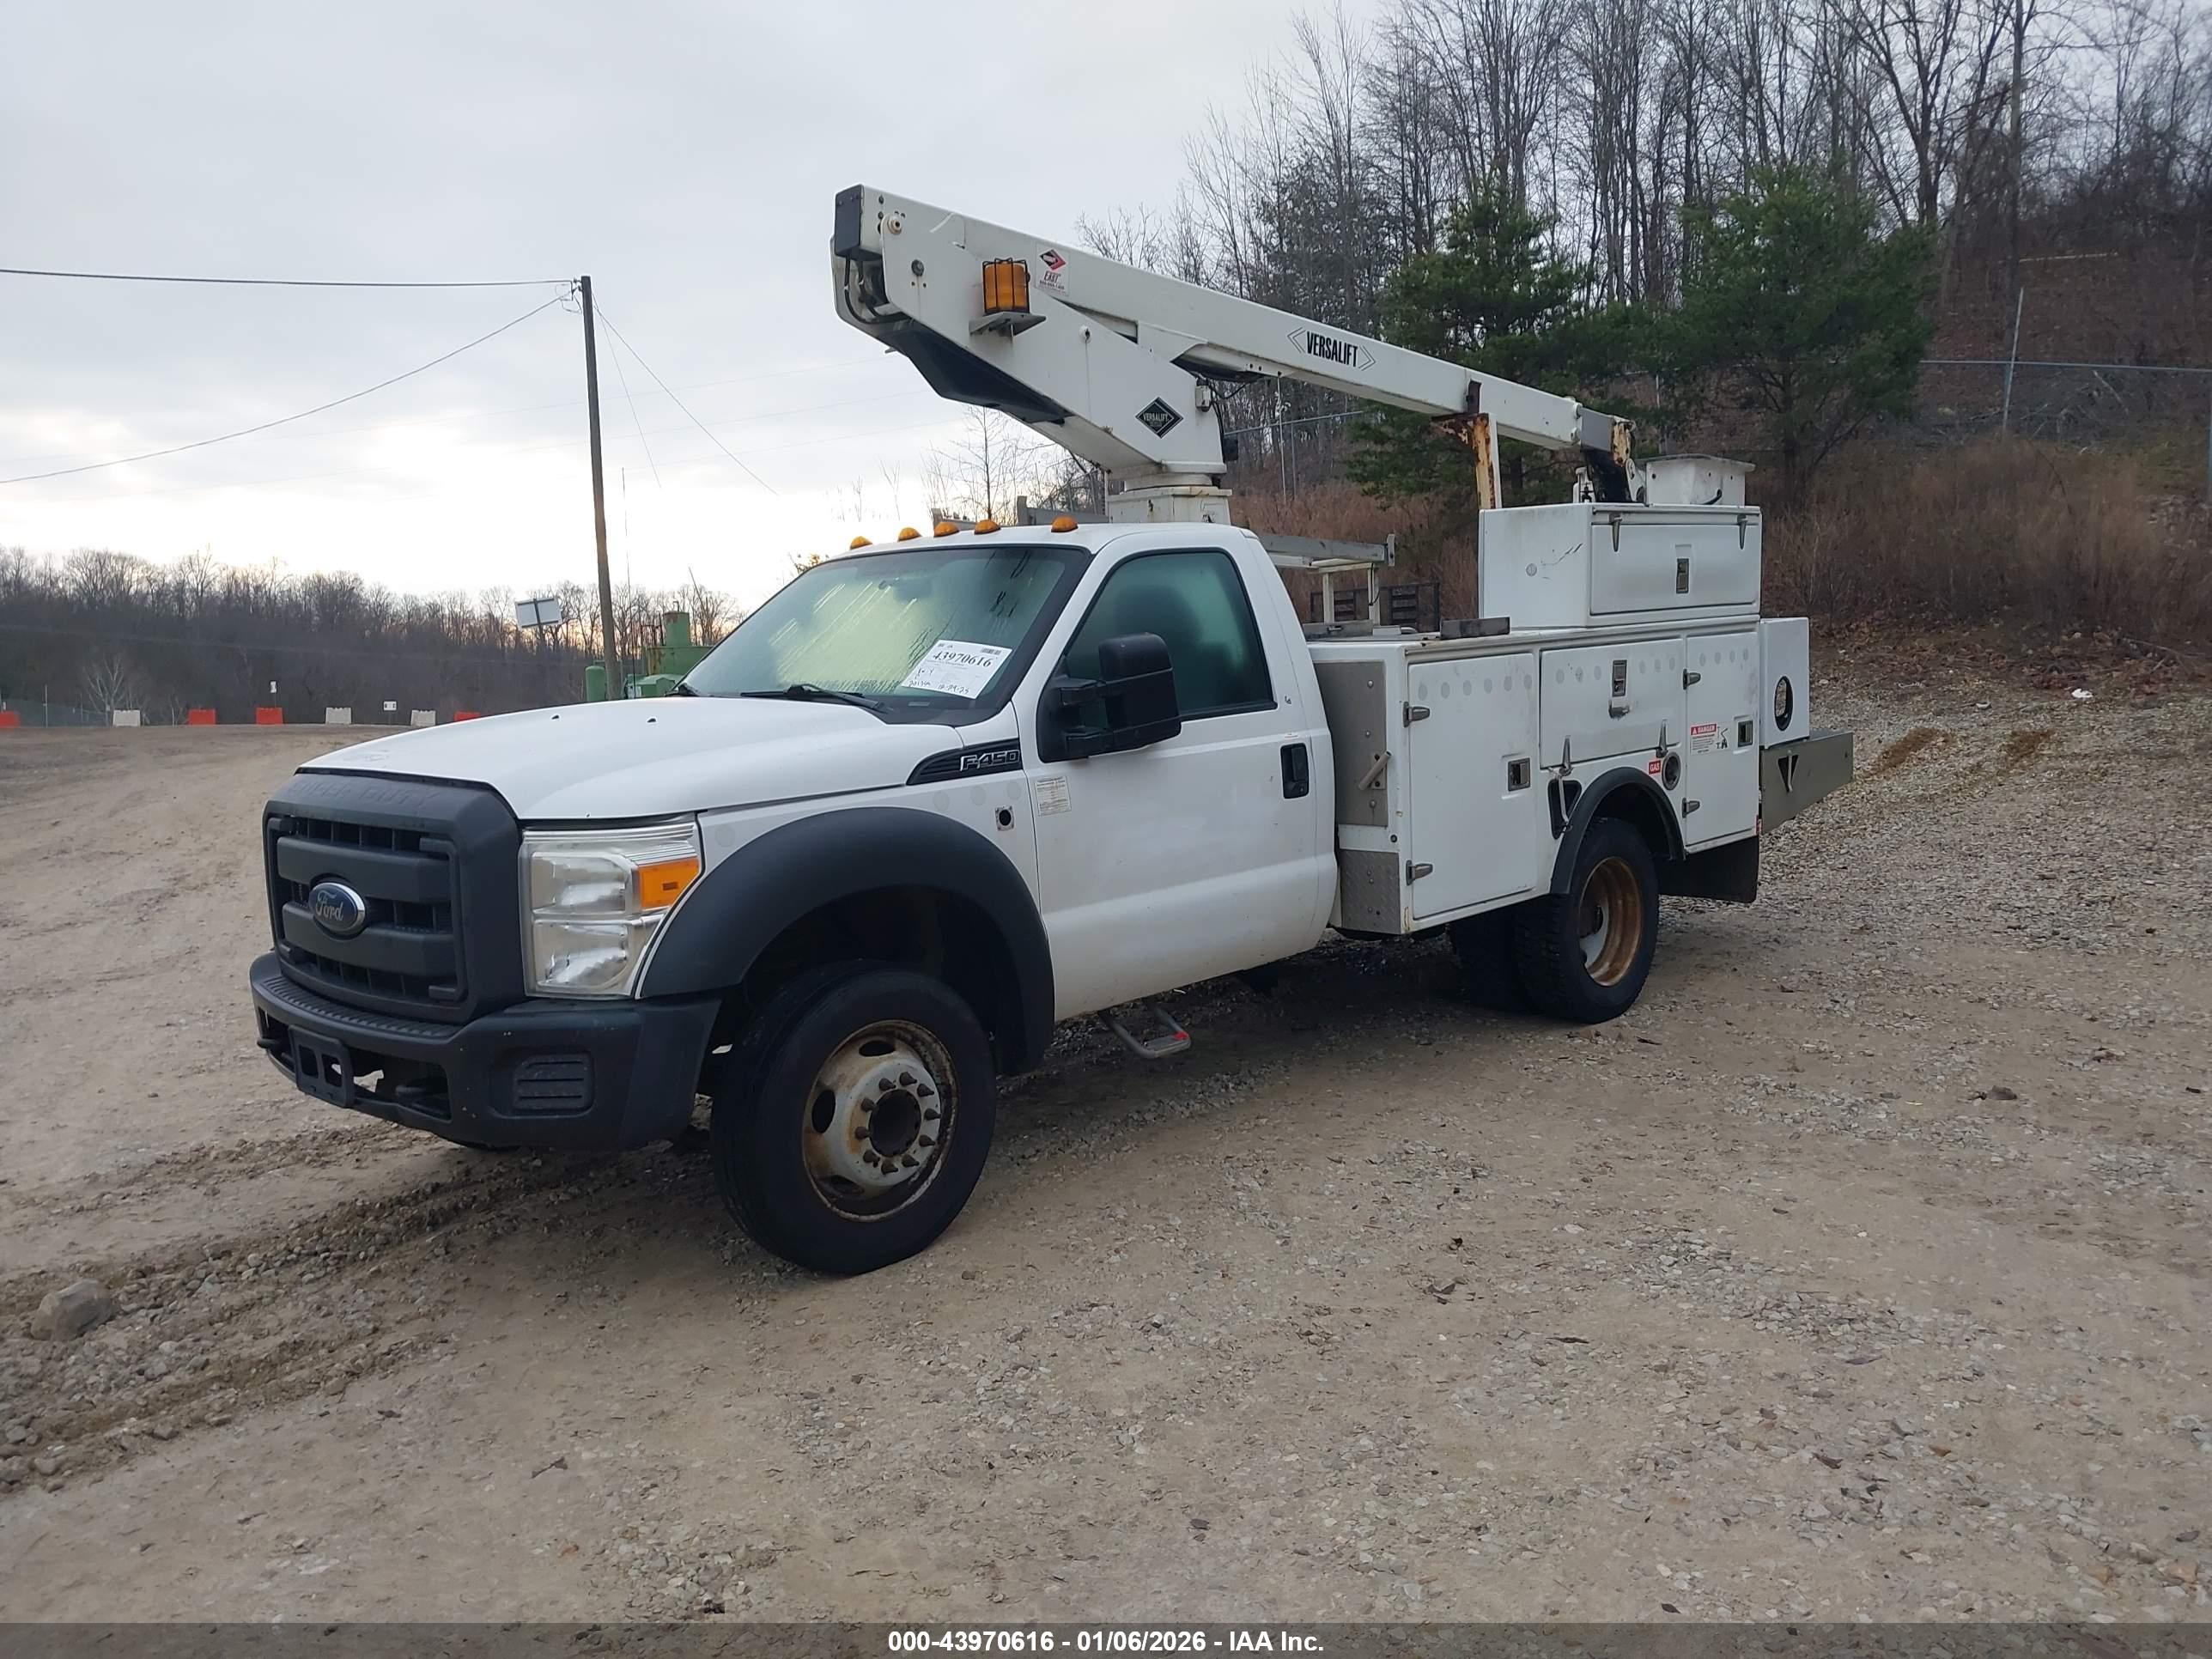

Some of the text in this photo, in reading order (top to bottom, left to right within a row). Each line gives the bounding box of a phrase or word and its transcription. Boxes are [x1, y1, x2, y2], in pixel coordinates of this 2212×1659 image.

[1306, 331, 1358, 368] VERSALIFT
[933, 651, 994, 668] 43970616
[1650, 763, 1661, 773] GAS
[315, 890, 343, 921] Ford
